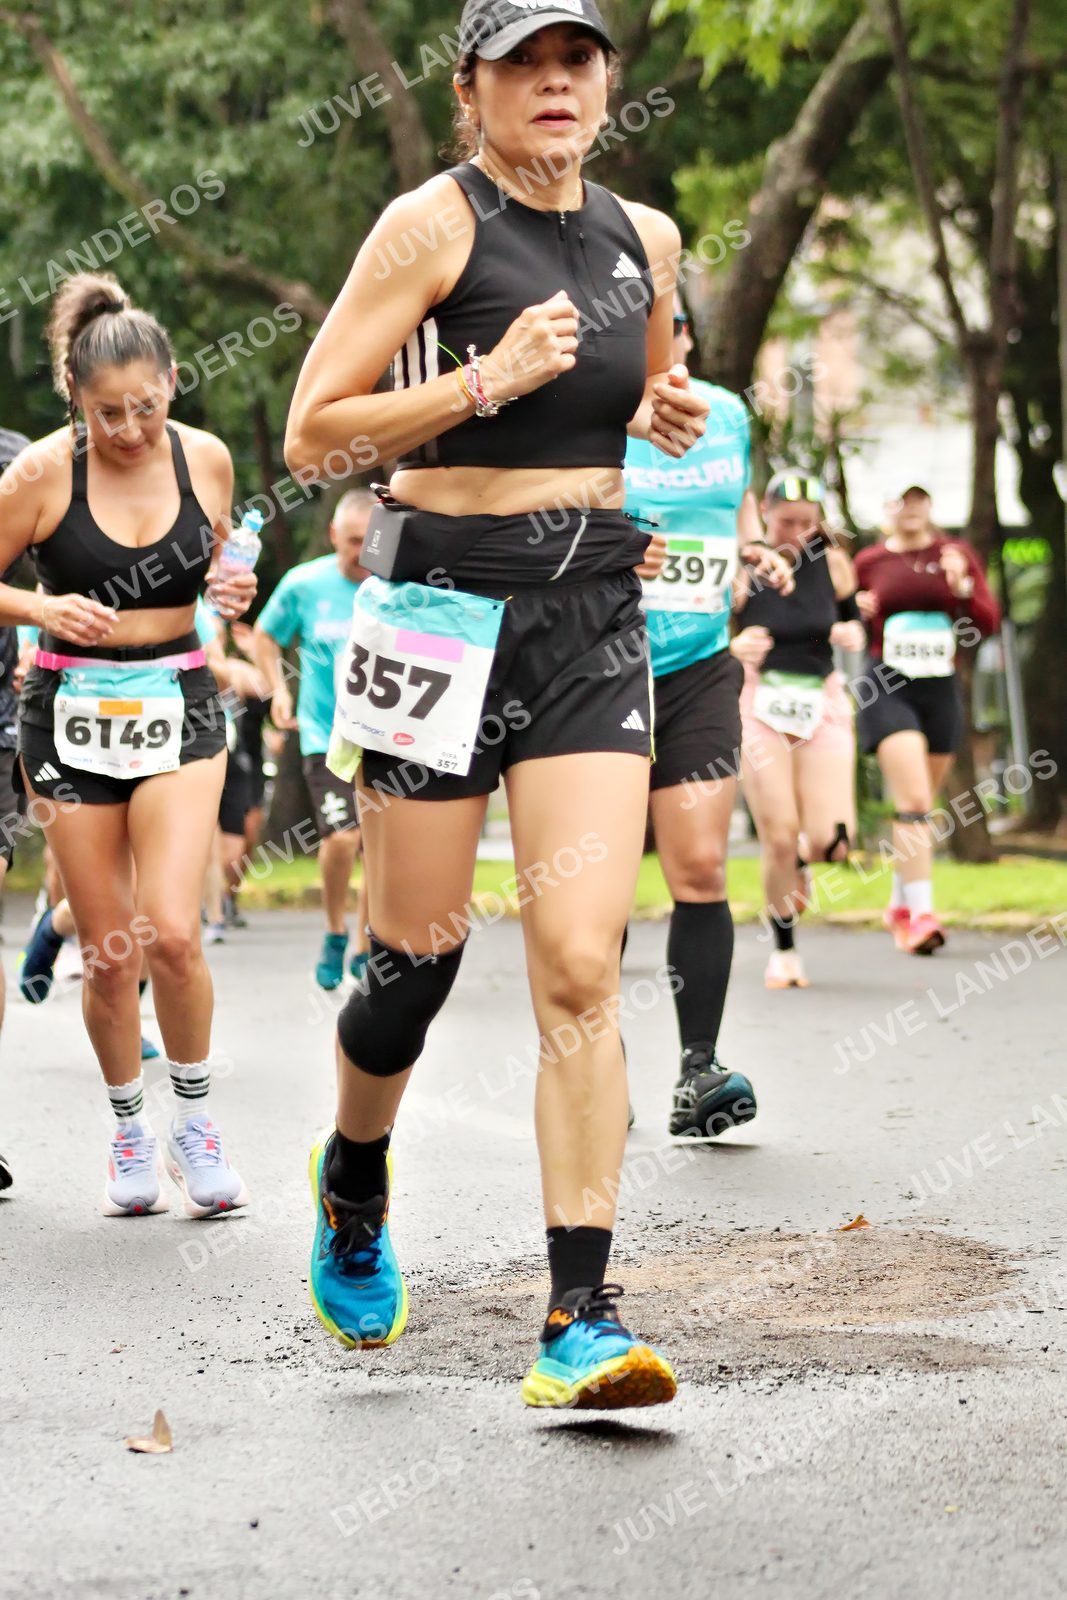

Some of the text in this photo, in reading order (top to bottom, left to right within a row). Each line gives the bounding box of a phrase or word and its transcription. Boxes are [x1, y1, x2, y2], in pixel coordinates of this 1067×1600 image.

[641, 555, 728, 585] 397
[346, 641, 452, 721] 357
[65, 716, 172, 750] 6149
[436, 758, 458, 771] 357
